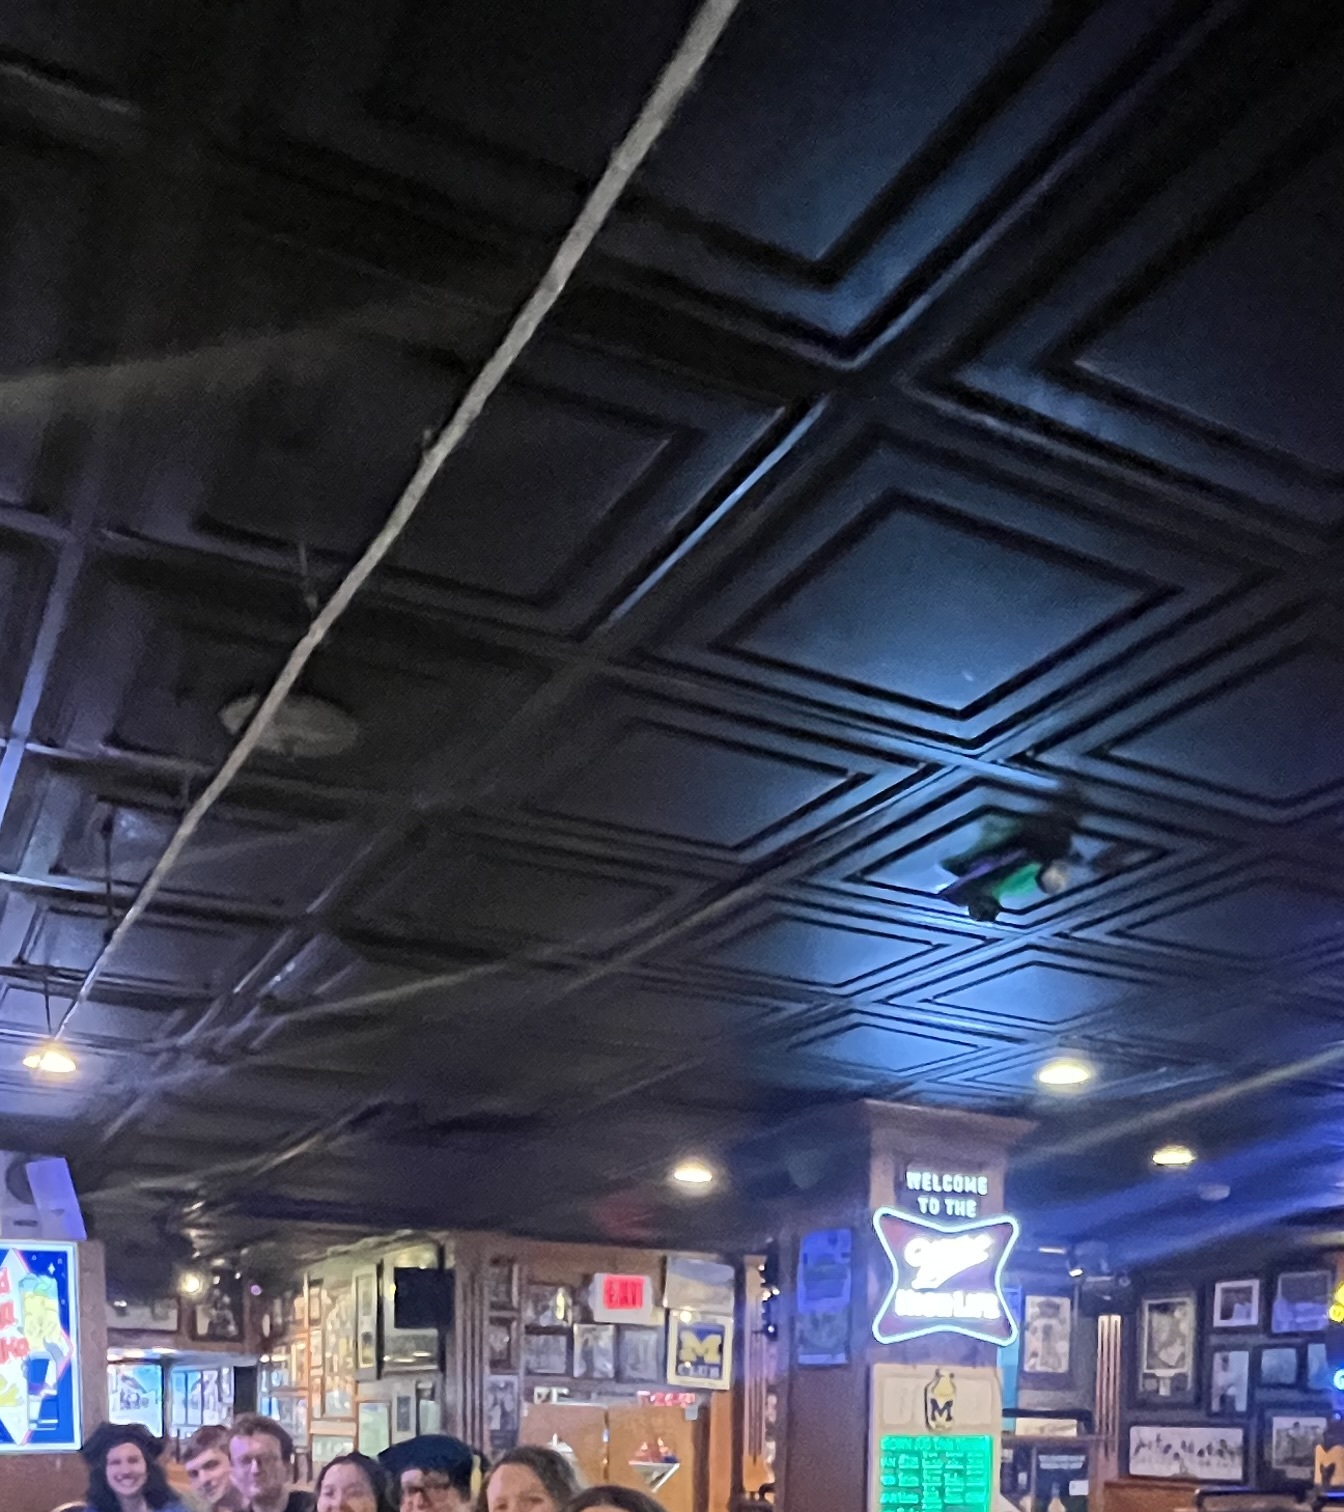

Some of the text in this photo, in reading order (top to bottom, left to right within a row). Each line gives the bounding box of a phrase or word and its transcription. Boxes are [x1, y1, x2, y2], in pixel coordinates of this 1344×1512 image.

[906, 1172, 988, 1196] WELCOME
[917, 1196, 977, 1218] TO THE
